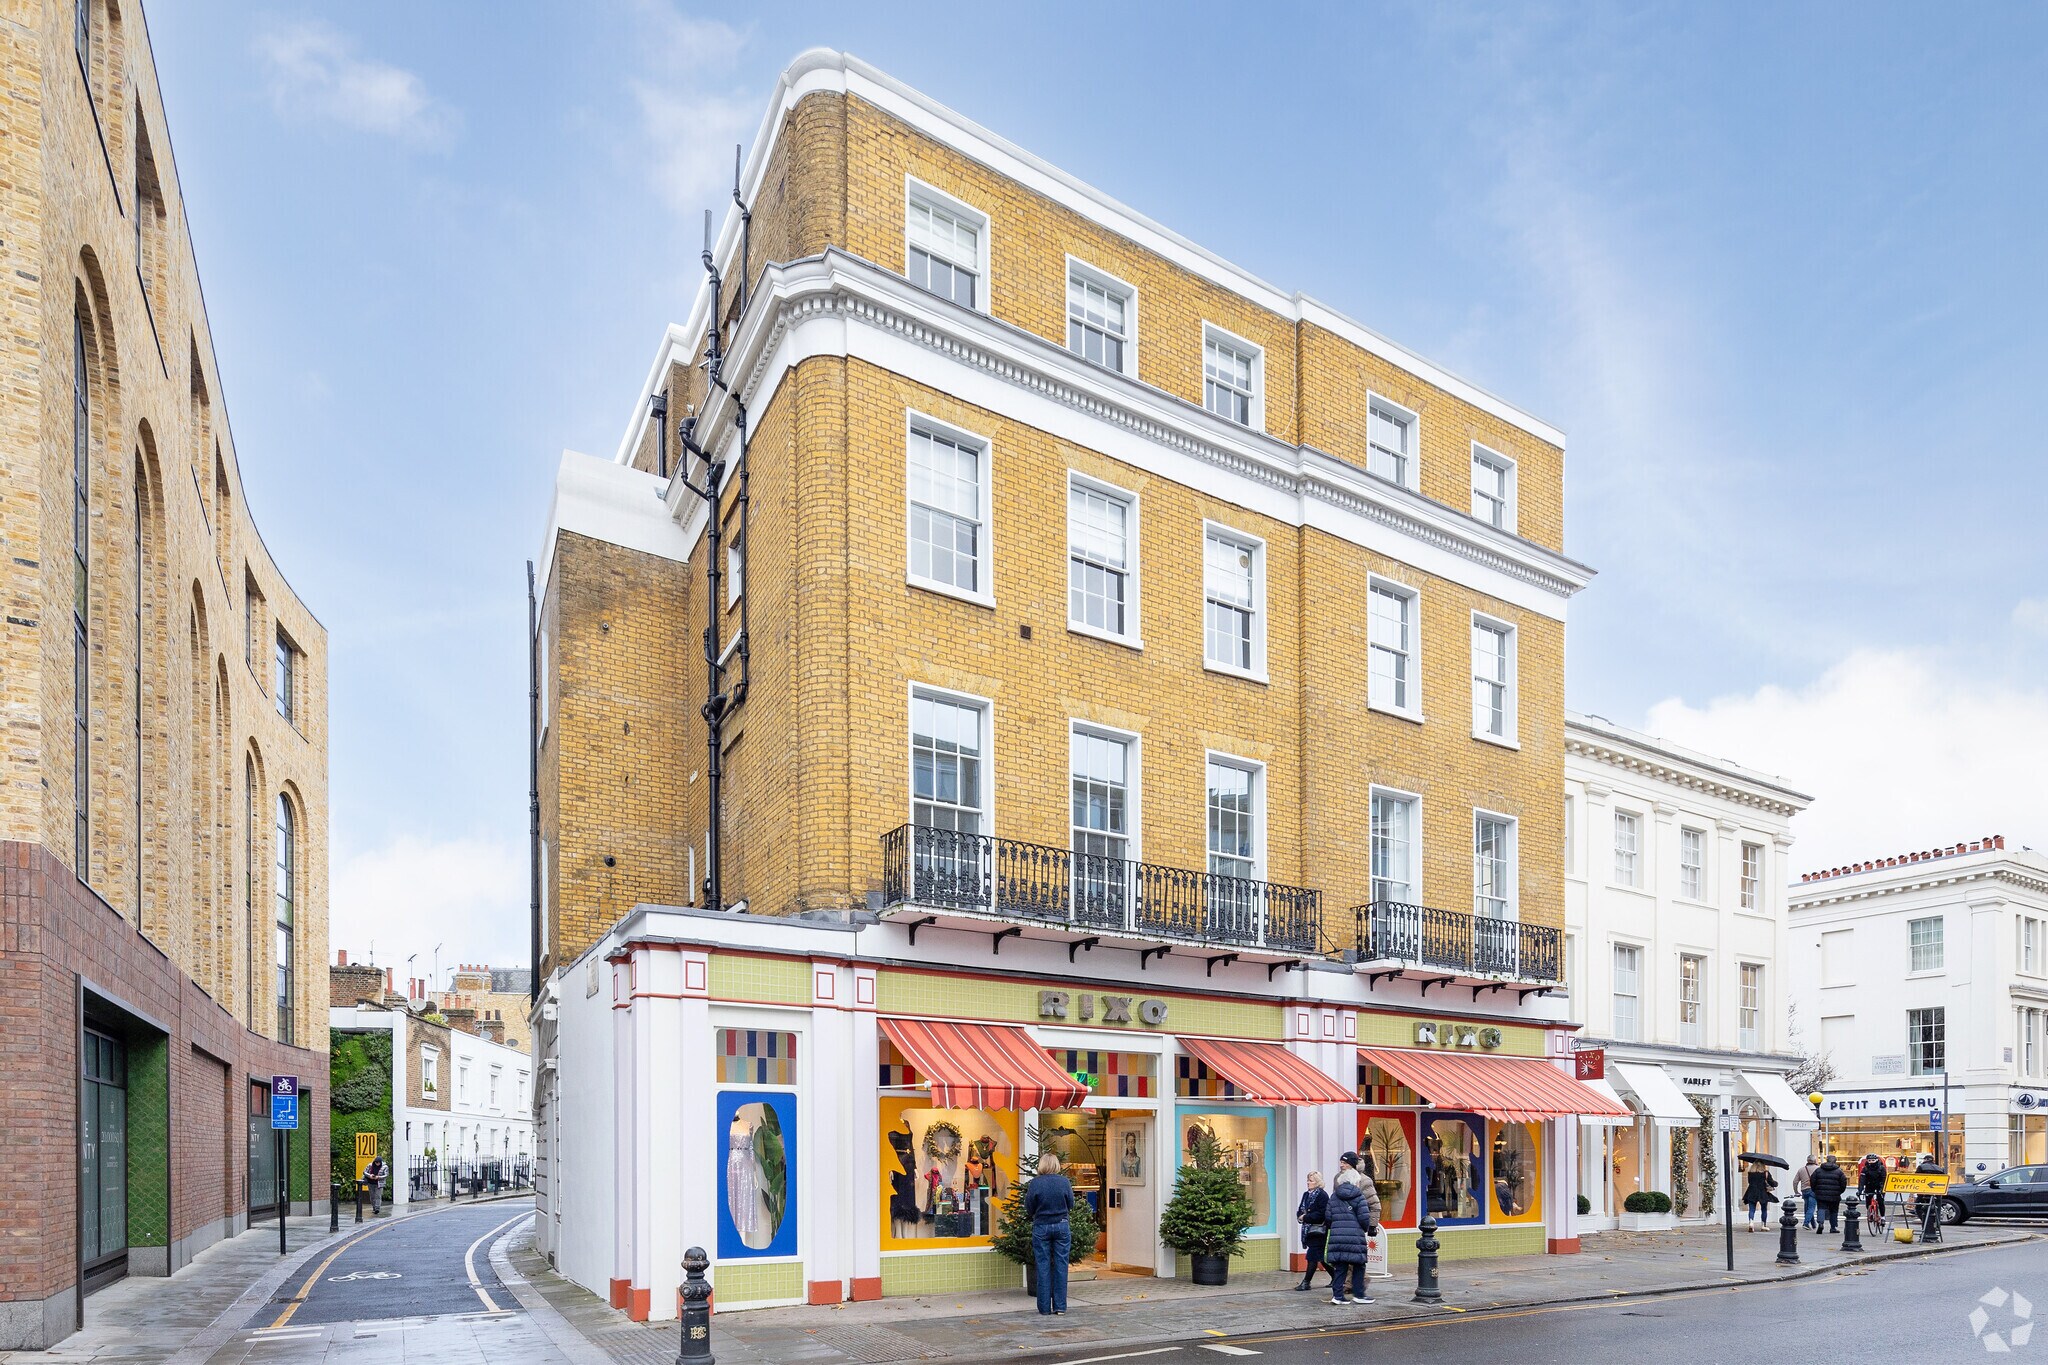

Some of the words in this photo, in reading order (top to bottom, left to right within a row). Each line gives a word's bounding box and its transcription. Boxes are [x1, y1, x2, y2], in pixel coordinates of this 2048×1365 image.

[1038, 990, 1168, 1026] RIXO
[1413, 1022, 1502, 1049] RIXO
[1682, 1077, 1712, 1087] VARLEY
[1830, 1100, 1869, 1110] PETIT
[1879, 1098, 1936, 1109] BATEAU
[357, 1134, 376, 1156] 120
